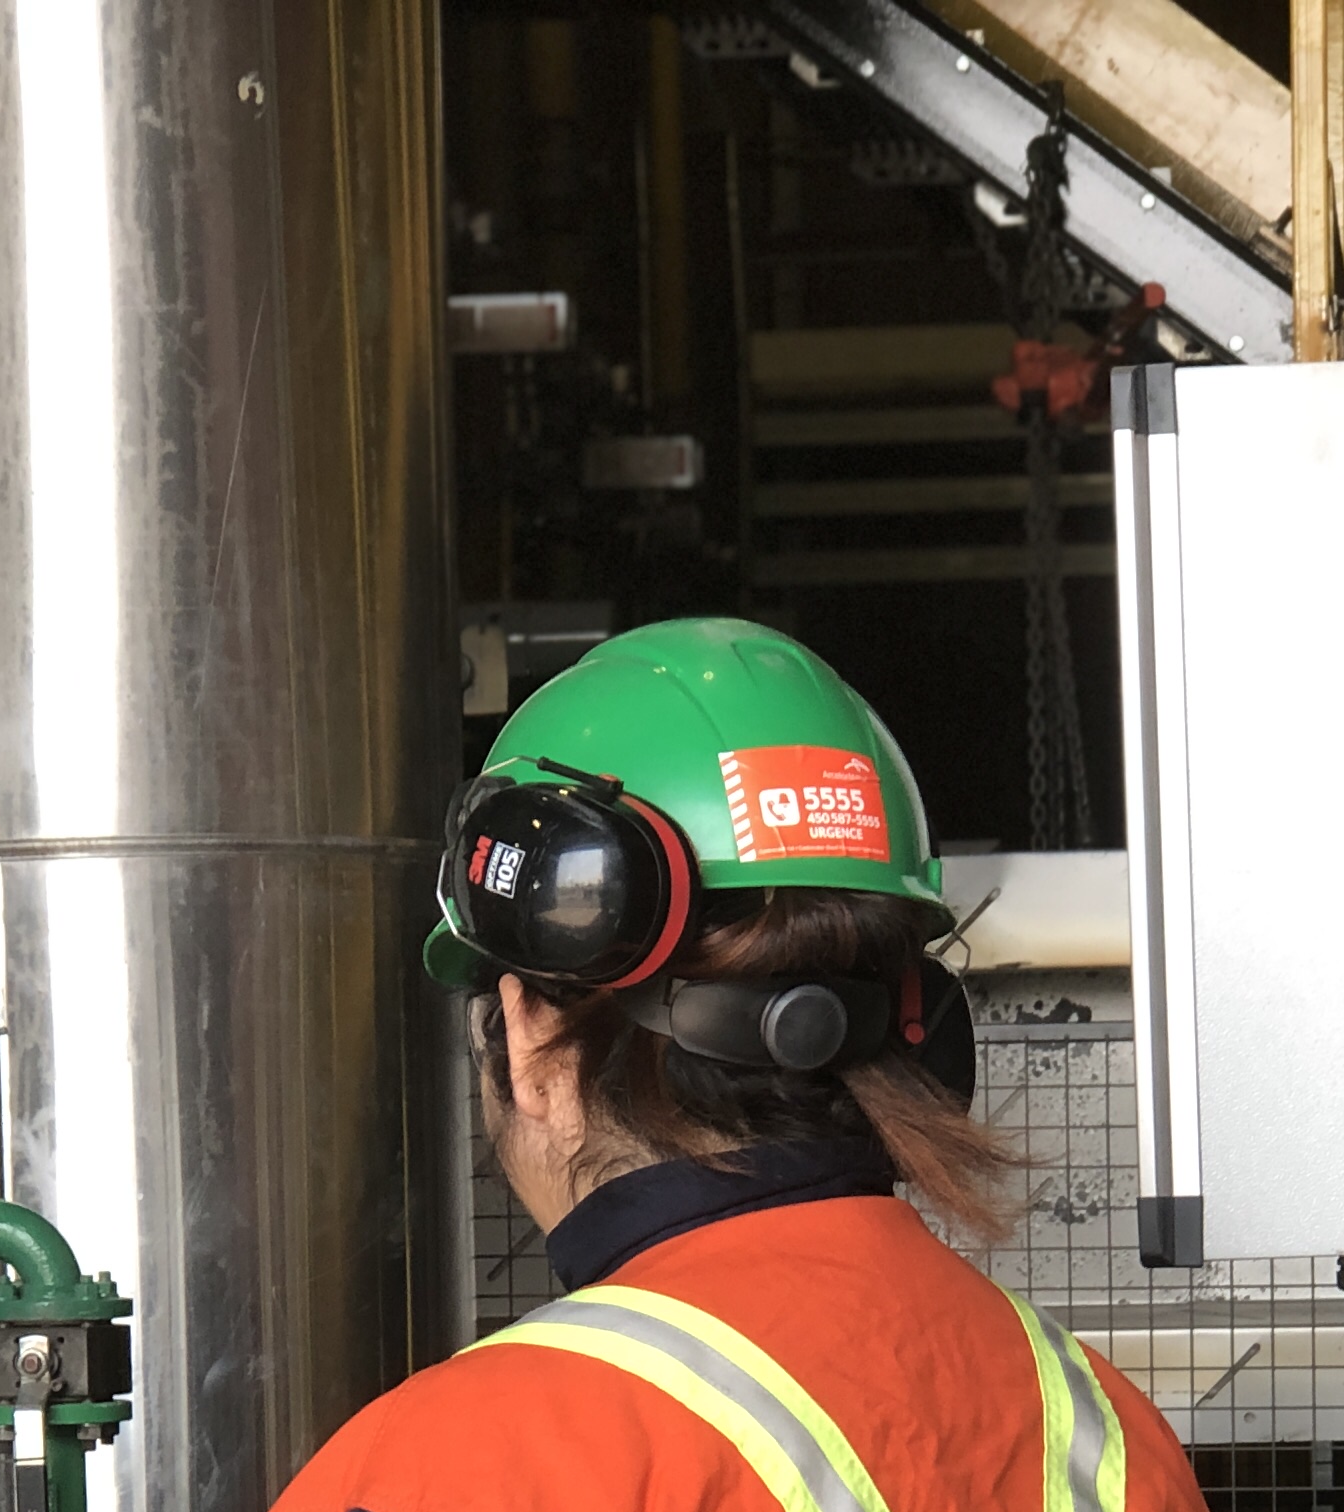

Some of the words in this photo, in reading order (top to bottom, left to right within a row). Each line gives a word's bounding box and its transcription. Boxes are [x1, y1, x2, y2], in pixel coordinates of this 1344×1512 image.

[802, 786, 865, 812] 5555
[807, 812, 830, 824] 450
[831, 813, 881, 829] 587-5555
[809, 826, 864, 841] URGENCE
[468, 835, 493, 885] 3M
[495, 851, 519, 892] 105
